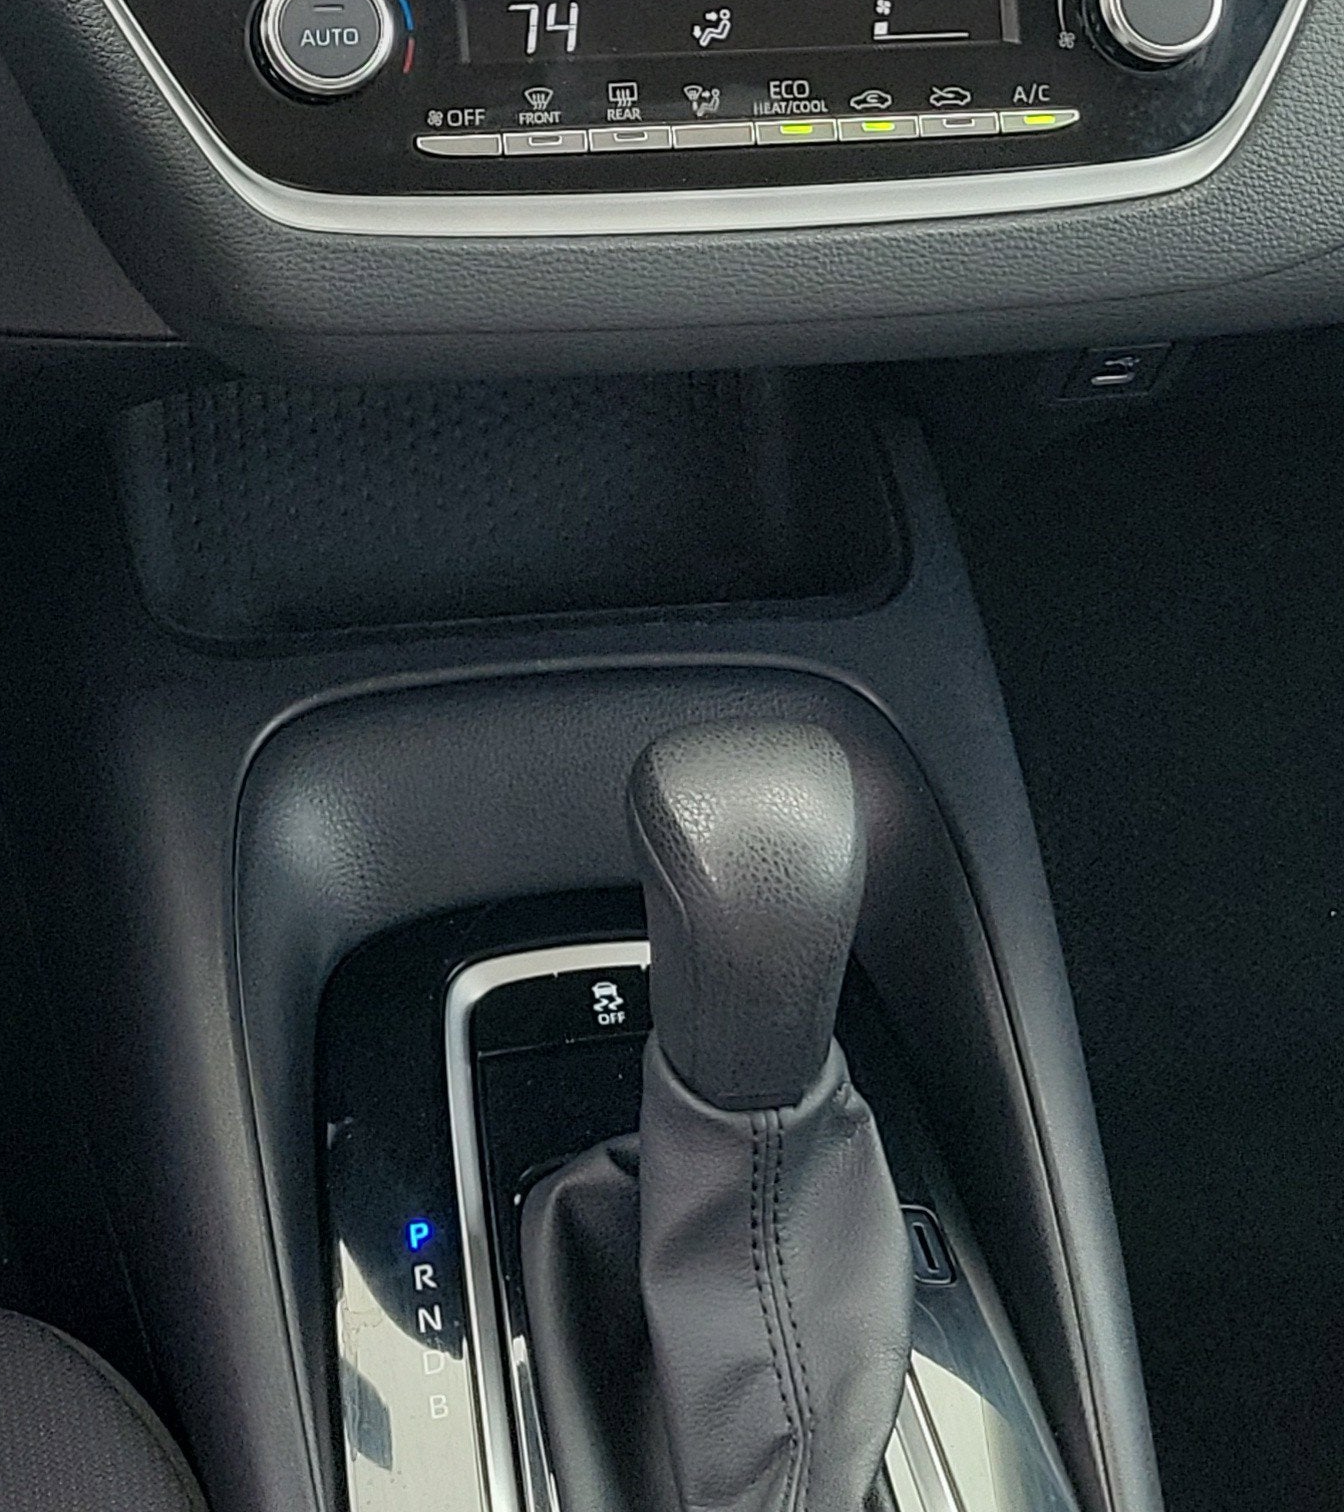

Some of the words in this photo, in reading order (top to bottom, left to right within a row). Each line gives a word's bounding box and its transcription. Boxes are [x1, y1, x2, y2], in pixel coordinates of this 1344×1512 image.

[299, 27, 360, 49] AUTO
[507, 1, 580, 56] 74
[768, 79, 810, 100] ECO
[1012, 84, 1051, 104] A/C
[446, 108, 487, 127] OFF
[518, 111, 562, 125] FRONT
[607, 107, 642, 122] REAR
[753, 99, 829, 116] HEAT/COOL
[597, 1010, 626, 1026] OFF
[409, 1221, 431, 1249] P
[413, 1263, 438, 1291] R
[417, 1304, 443, 1334] N
[422, 1350, 446, 1376] D
[429, 1394, 449, 1420] B
